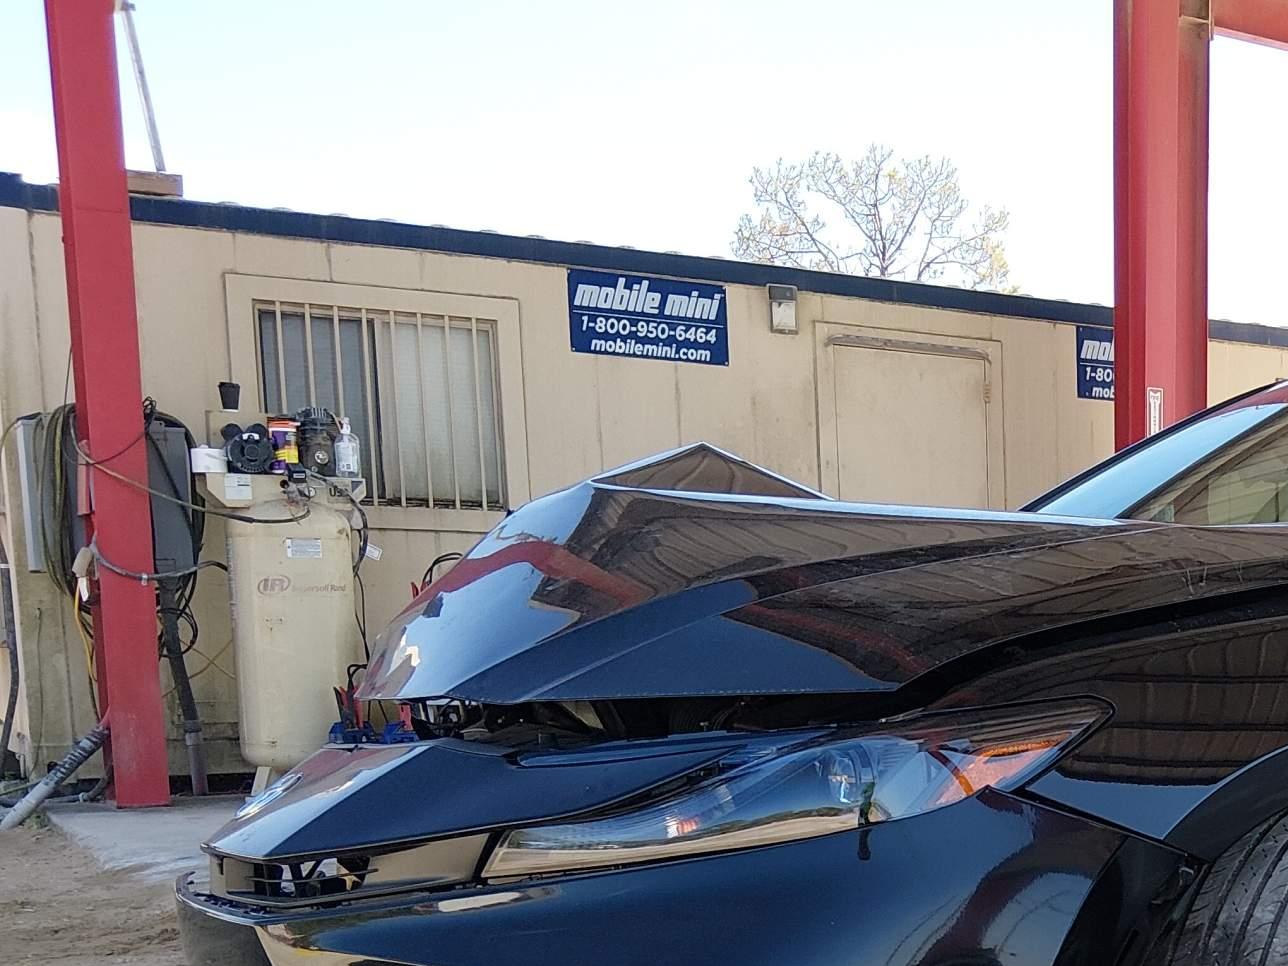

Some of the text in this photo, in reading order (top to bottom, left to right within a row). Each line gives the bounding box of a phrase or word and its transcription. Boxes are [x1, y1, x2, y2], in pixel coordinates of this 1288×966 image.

[573, 277, 721, 320] mobile mini
[581, 315, 717, 344] 1-800-950-6464
[590, 338, 711, 362] mobilemini.com
